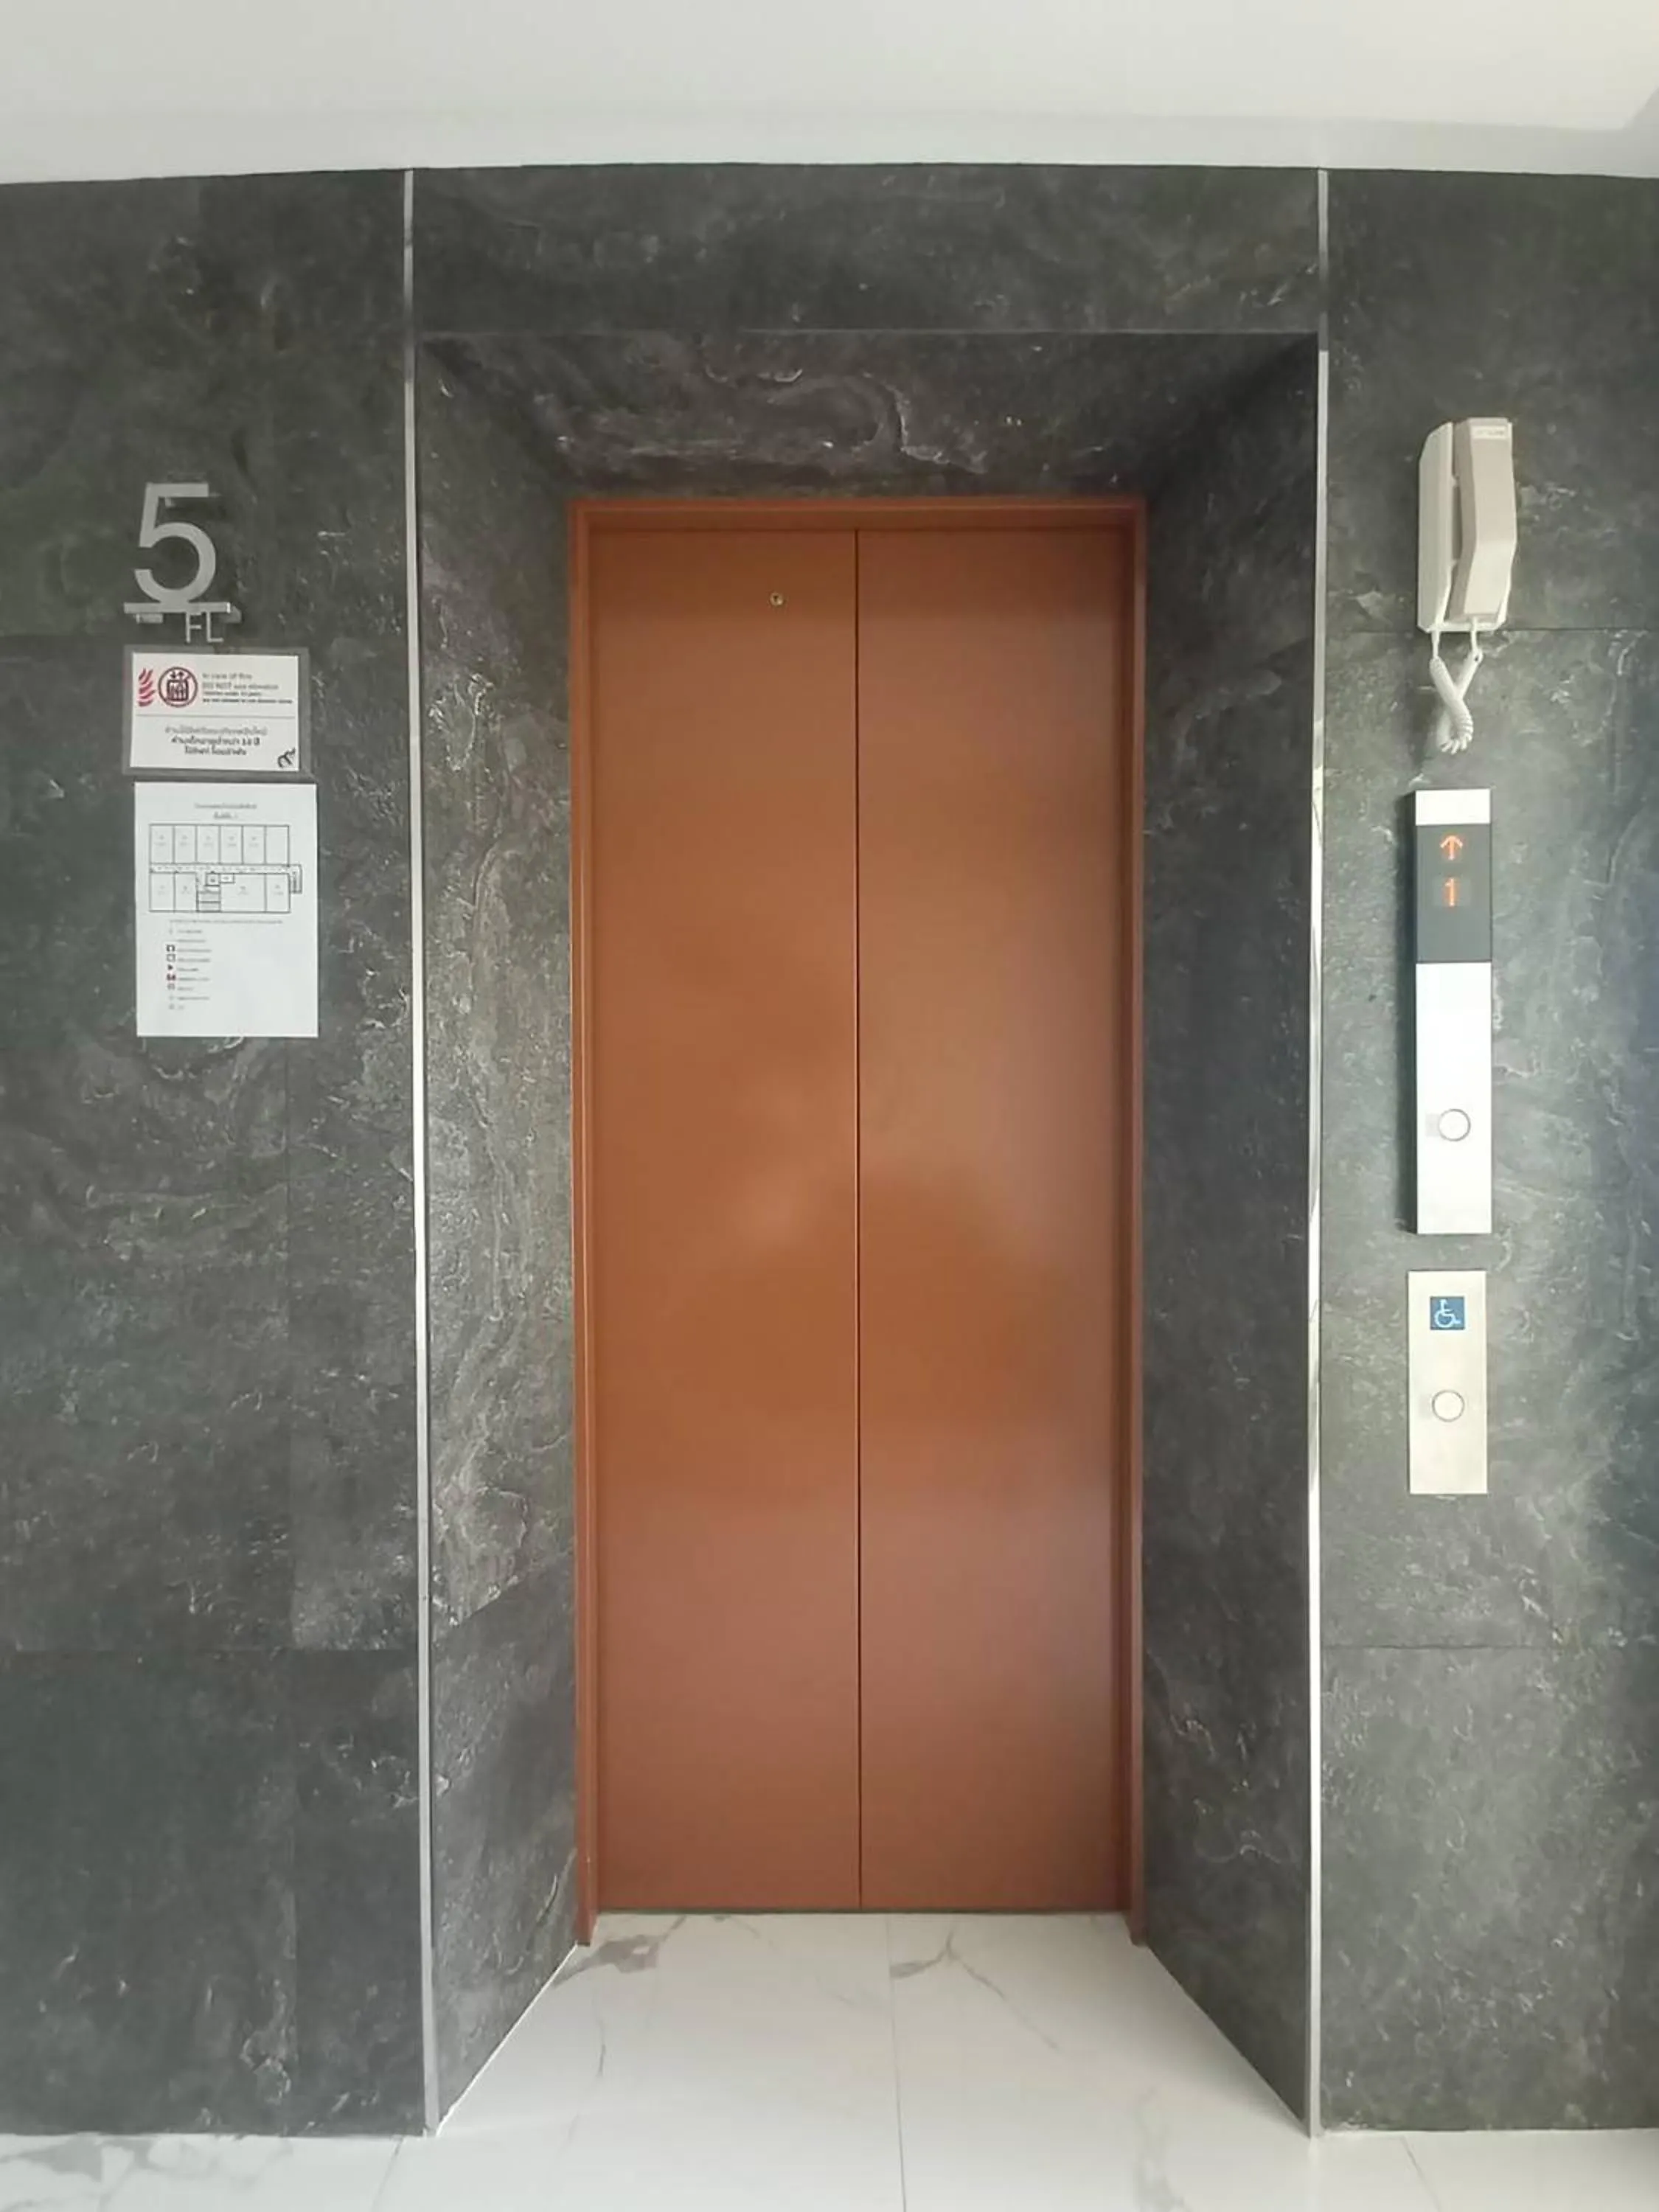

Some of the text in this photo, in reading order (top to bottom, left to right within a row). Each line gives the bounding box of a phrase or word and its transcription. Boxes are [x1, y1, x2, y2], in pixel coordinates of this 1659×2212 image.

[134, 481, 216, 604] 5
[185, 611, 224, 643] FL
[1444, 877, 1455, 907] 1
